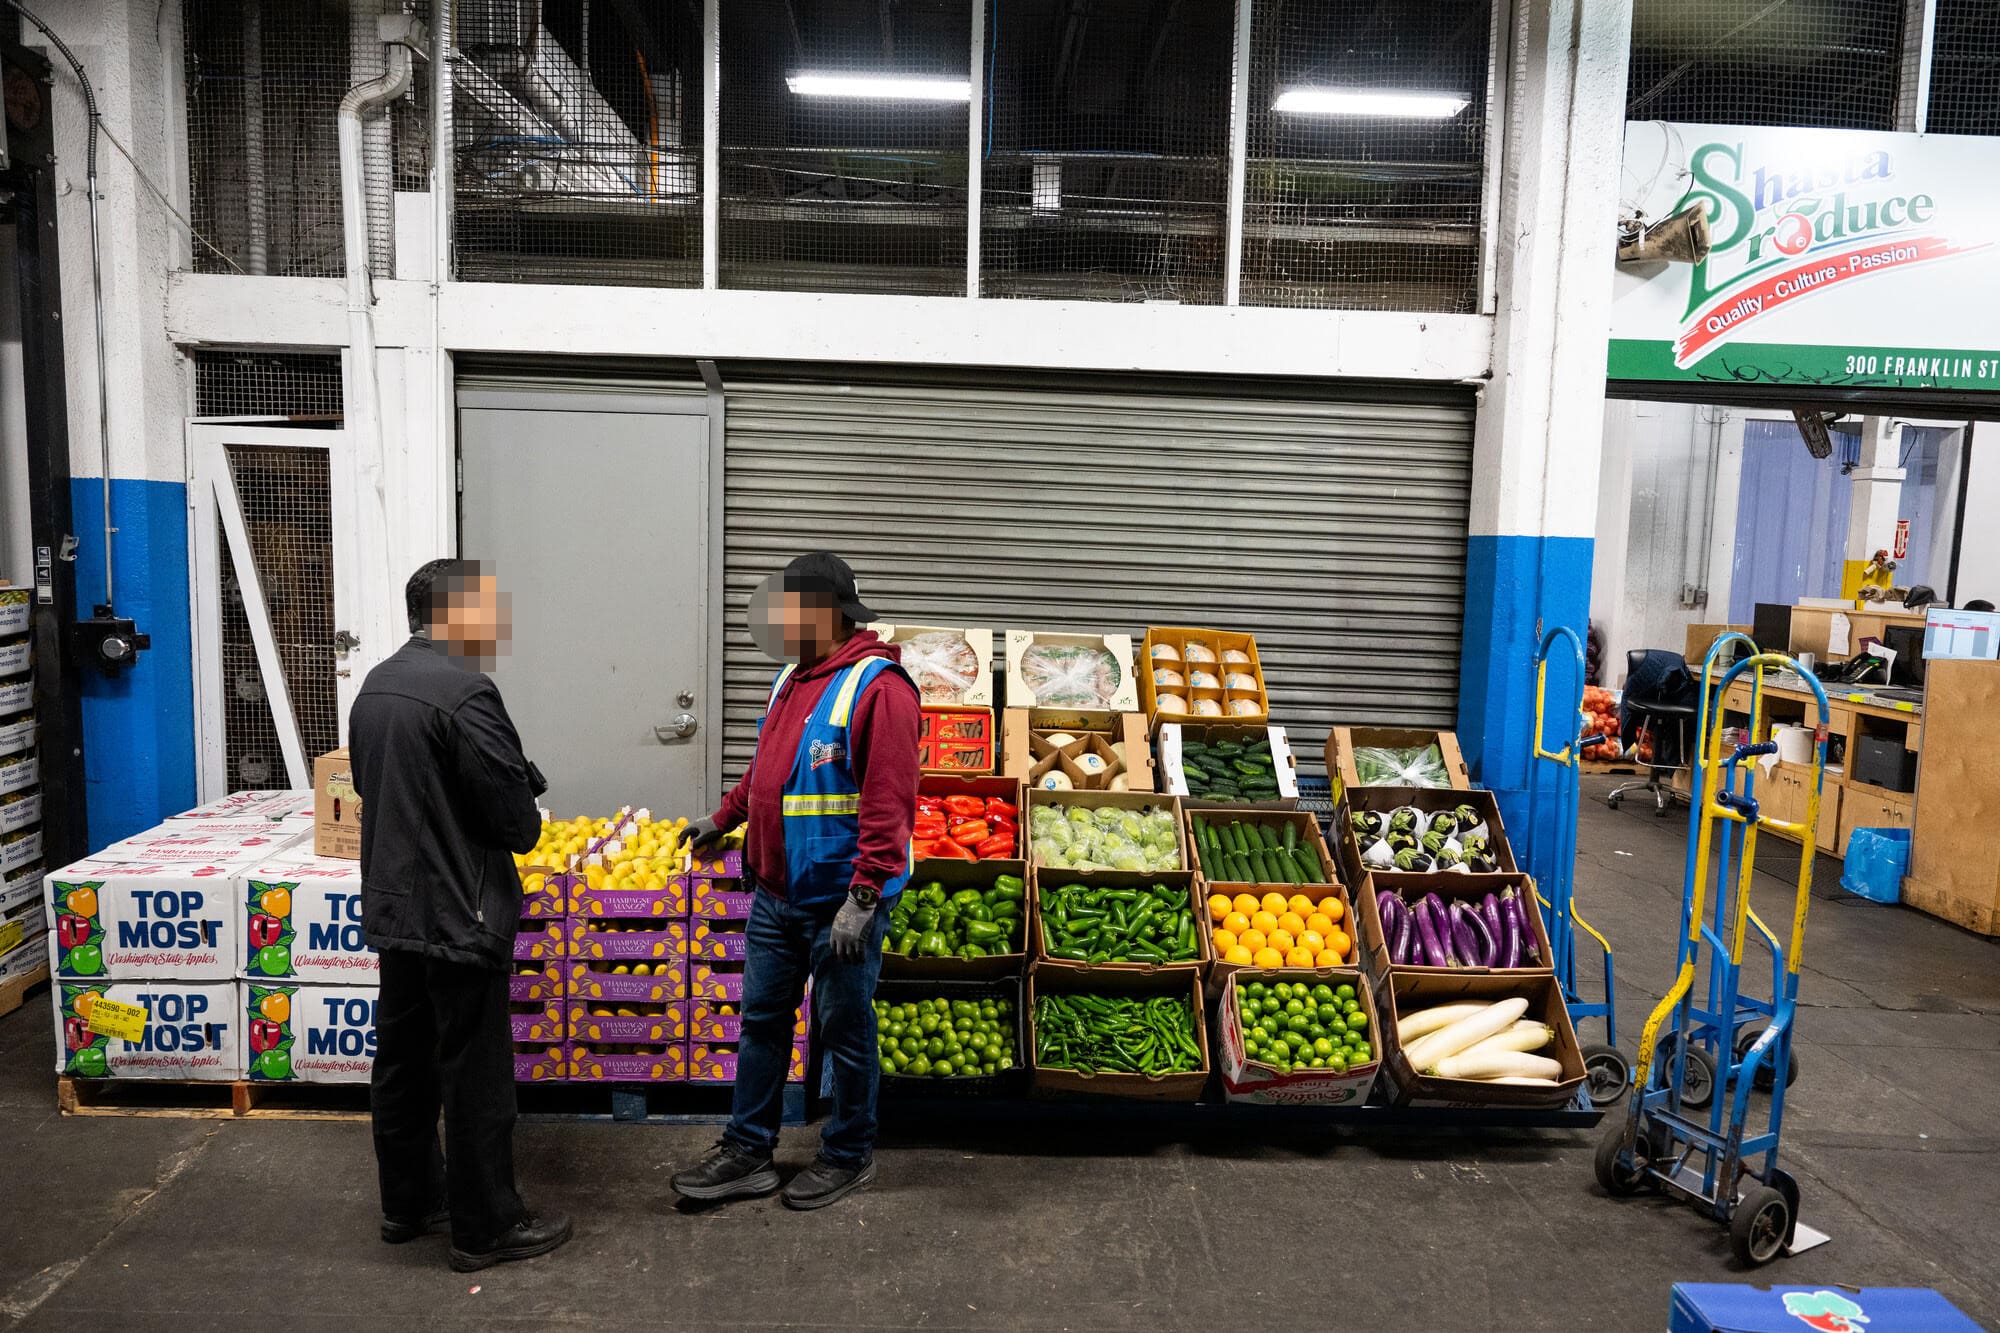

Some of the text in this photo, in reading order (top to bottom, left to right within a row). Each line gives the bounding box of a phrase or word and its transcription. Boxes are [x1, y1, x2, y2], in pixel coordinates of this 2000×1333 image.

[1690, 142, 1892, 252] Shasta
[1673, 191, 1934, 324] Produce
[1706, 293, 1764, 333] Quality
[1775, 264, 1837, 298] Culture
[1848, 244, 1918, 273] Passion
[1845, 355, 1877, 375] 300
[1884, 356, 1972, 378] FRANKLIN
[1978, 359, 2000, 379] ST
[2, 763, 33, 778] Super Sweet
[3, 773, 31, 787] Pineapples
[4, 805, 19, 815] Super
[6, 811, 33, 824] Pineapples
[6, 844, 21, 854] Super
[8, 849, 34, 863] Pineapples
[131, 890, 204, 919] TOP
[118, 920, 223, 949] MOST
[309, 922, 379, 954] MO
[109, 952, 159, 967] Washington
[159, 952, 184, 966] State
[294, 955, 345, 970] Washington
[345, 956, 370, 970] State
[136, 994, 209, 1022] TOP
[323, 998, 377, 1027] TO
[110, 1055, 162, 1070] Washington
[162, 1055, 186, 1068] State
[295, 1059, 371, 1076] Washington State
